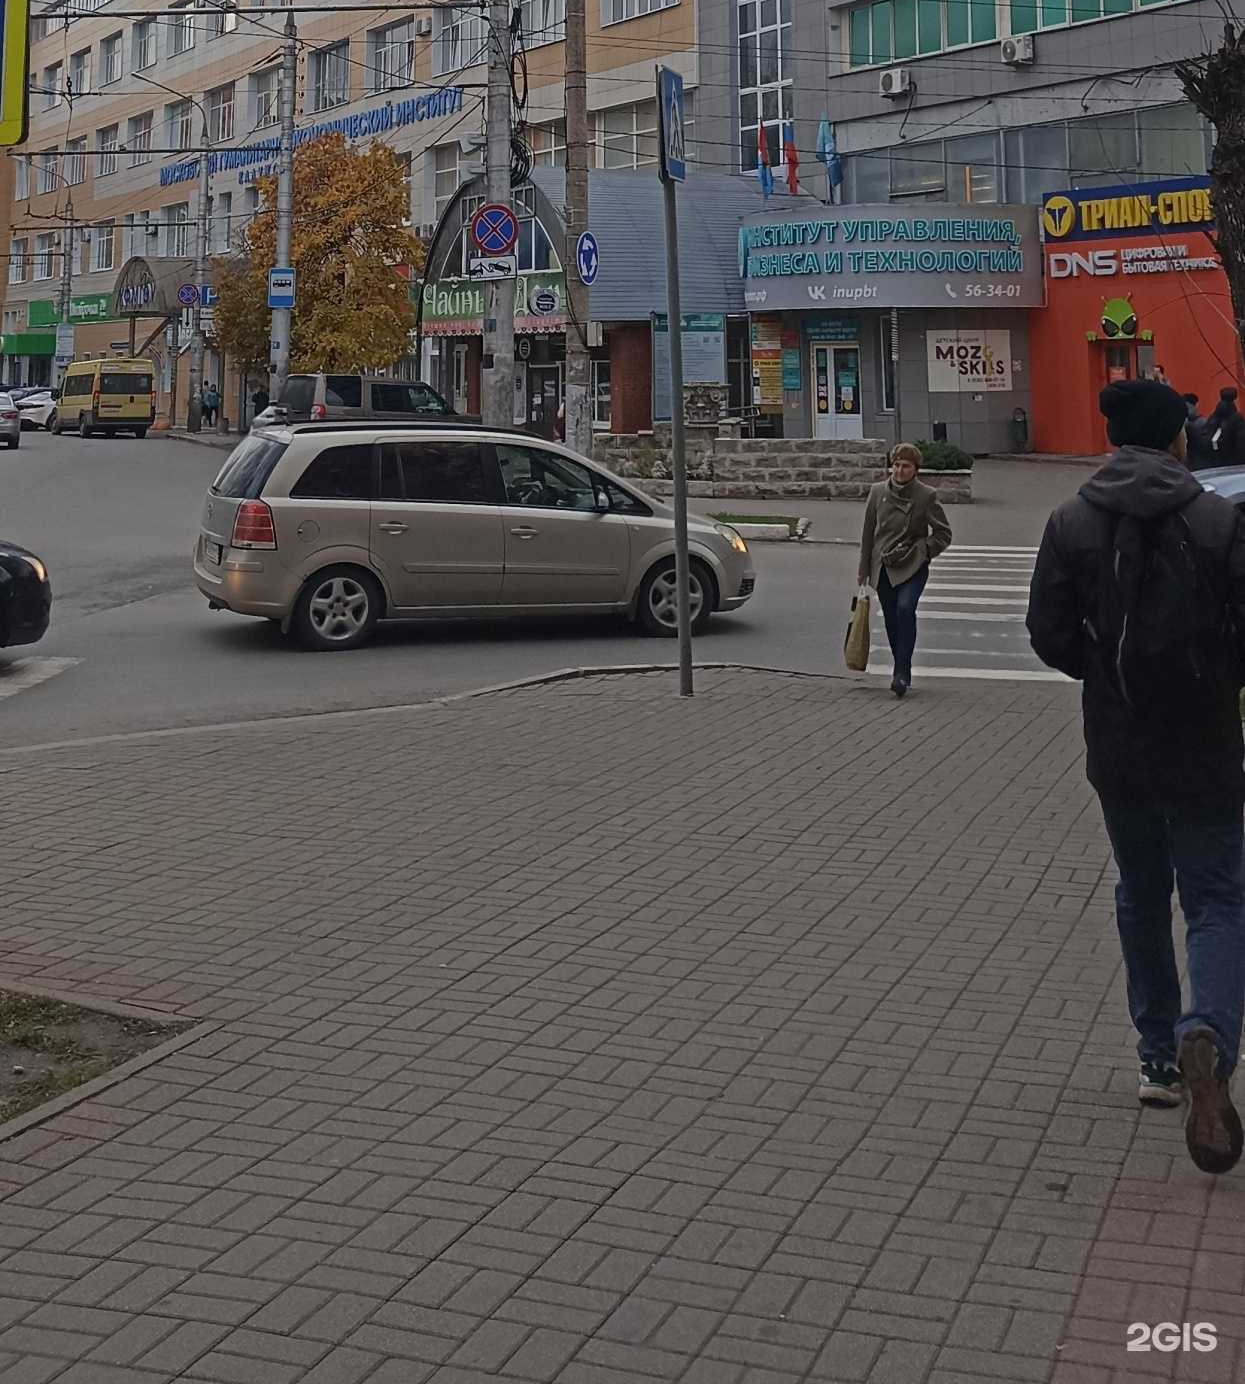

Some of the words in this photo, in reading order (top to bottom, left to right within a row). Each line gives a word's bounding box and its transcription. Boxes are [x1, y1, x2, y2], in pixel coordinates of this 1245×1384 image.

[396, 86, 464, 127] ИНСТИТУТ
[841, 219, 1022, 246] УПРАВЛЕНИЯ,
[824, 250, 842, 273] И
[847, 246, 1024, 273] ТЕХНОЛОГИЙ
[1050, 249, 1119, 278] DNS
[833, 284, 878, 300] inupbt
[965, 284, 1022, 297] 56-34-01
